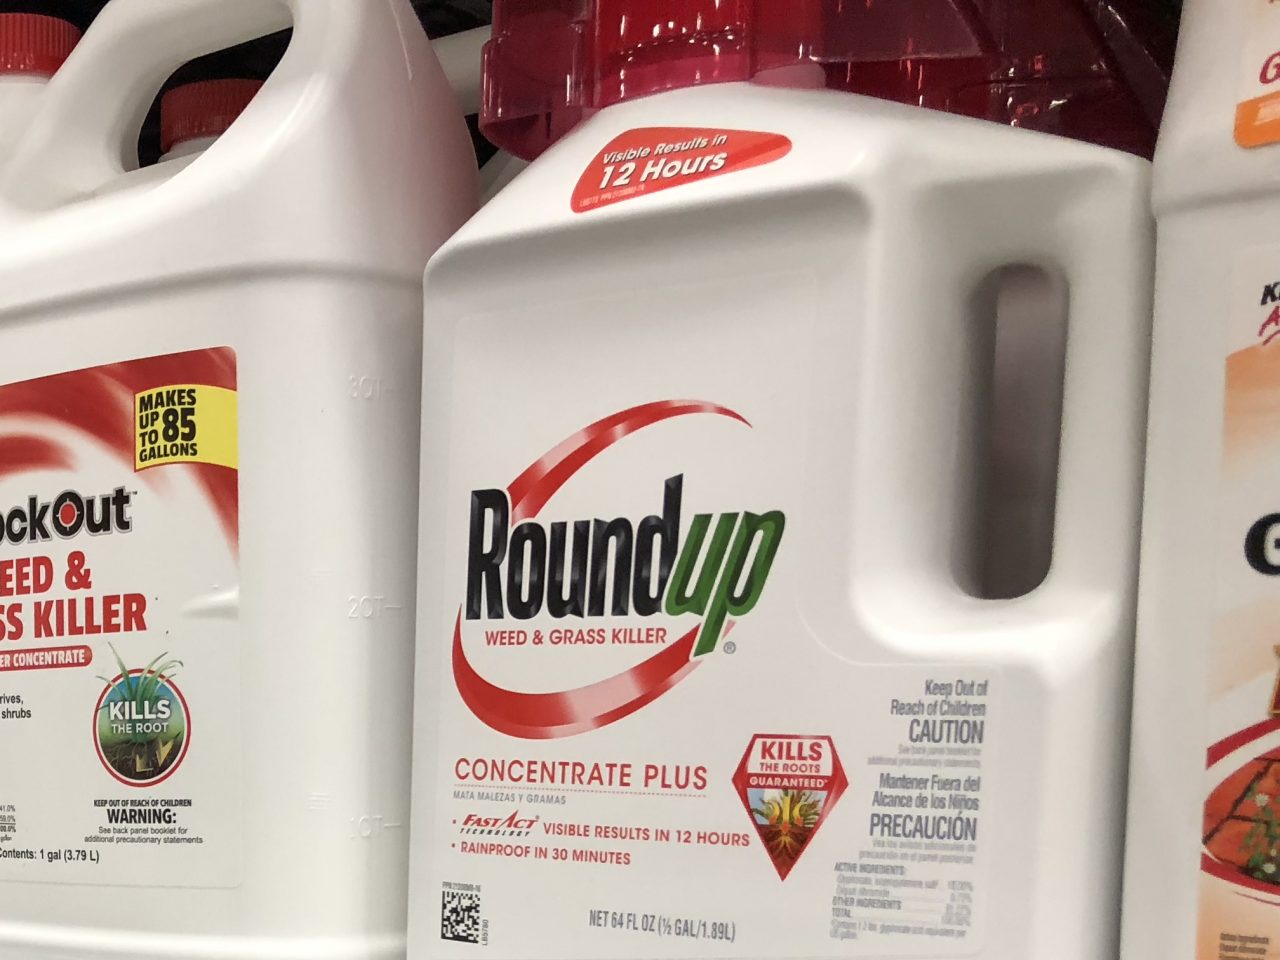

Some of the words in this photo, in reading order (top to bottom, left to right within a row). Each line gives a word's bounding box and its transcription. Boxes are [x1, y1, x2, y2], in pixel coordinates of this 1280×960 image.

[602, 146, 651, 165] Visible
[654, 137, 708, 156] Results
[712, 134, 728, 147] in
[599, 162, 637, 190] 12
[640, 152, 728, 183] Hours
[139, 388, 197, 414] MAKES
[139, 411, 160, 430] UP
[139, 429, 159, 448] TO
[161, 407, 197, 443] 85
[139, 443, 198, 463] GALLONS
[65, 551, 92, 591] &
[465, 472, 787, 658] Roundup
[34, 593, 147, 638] KILLER
[485, 630, 528, 646] WEED
[532, 630, 544, 645] &
[549, 629, 606, 645] GRASS
[612, 628, 668, 645] KILLER
[13, 648, 85, 667] CONCENTRATE
[1, 708, 32, 719] shrubs
[109, 699, 171, 721] KILLS
[111, 723, 133, 734] THE
[135, 722, 169, 734] ROOT
[908, 718, 984, 744] CAUTION
[761, 741, 823, 761] KILLS
[455, 758, 632, 787] CONCENTRATE
[644, 764, 708, 790] PLUS
[759, 762, 779, 772] THE
[782, 763, 820, 773] ROOTS
[107, 808, 177, 824] WARNING:
[870, 811, 977, 840] PRECAUCIÓN
[544, 823, 590, 838] VISIBLE
[595, 825, 650, 841] RESULTS
[655, 829, 669, 842] IN
[676, 829, 692, 843] 12
[697, 831, 751, 847] HOURS
[47, 849, 61, 863] gal
[64, 849, 87, 863] (3.79
[89, 850, 100, 864] L)
[460, 841, 531, 858] RAINPROOF
[534, 846, 548, 859] IN
[552, 847, 568, 860] 30
[572, 848, 631, 865] MINUTES
